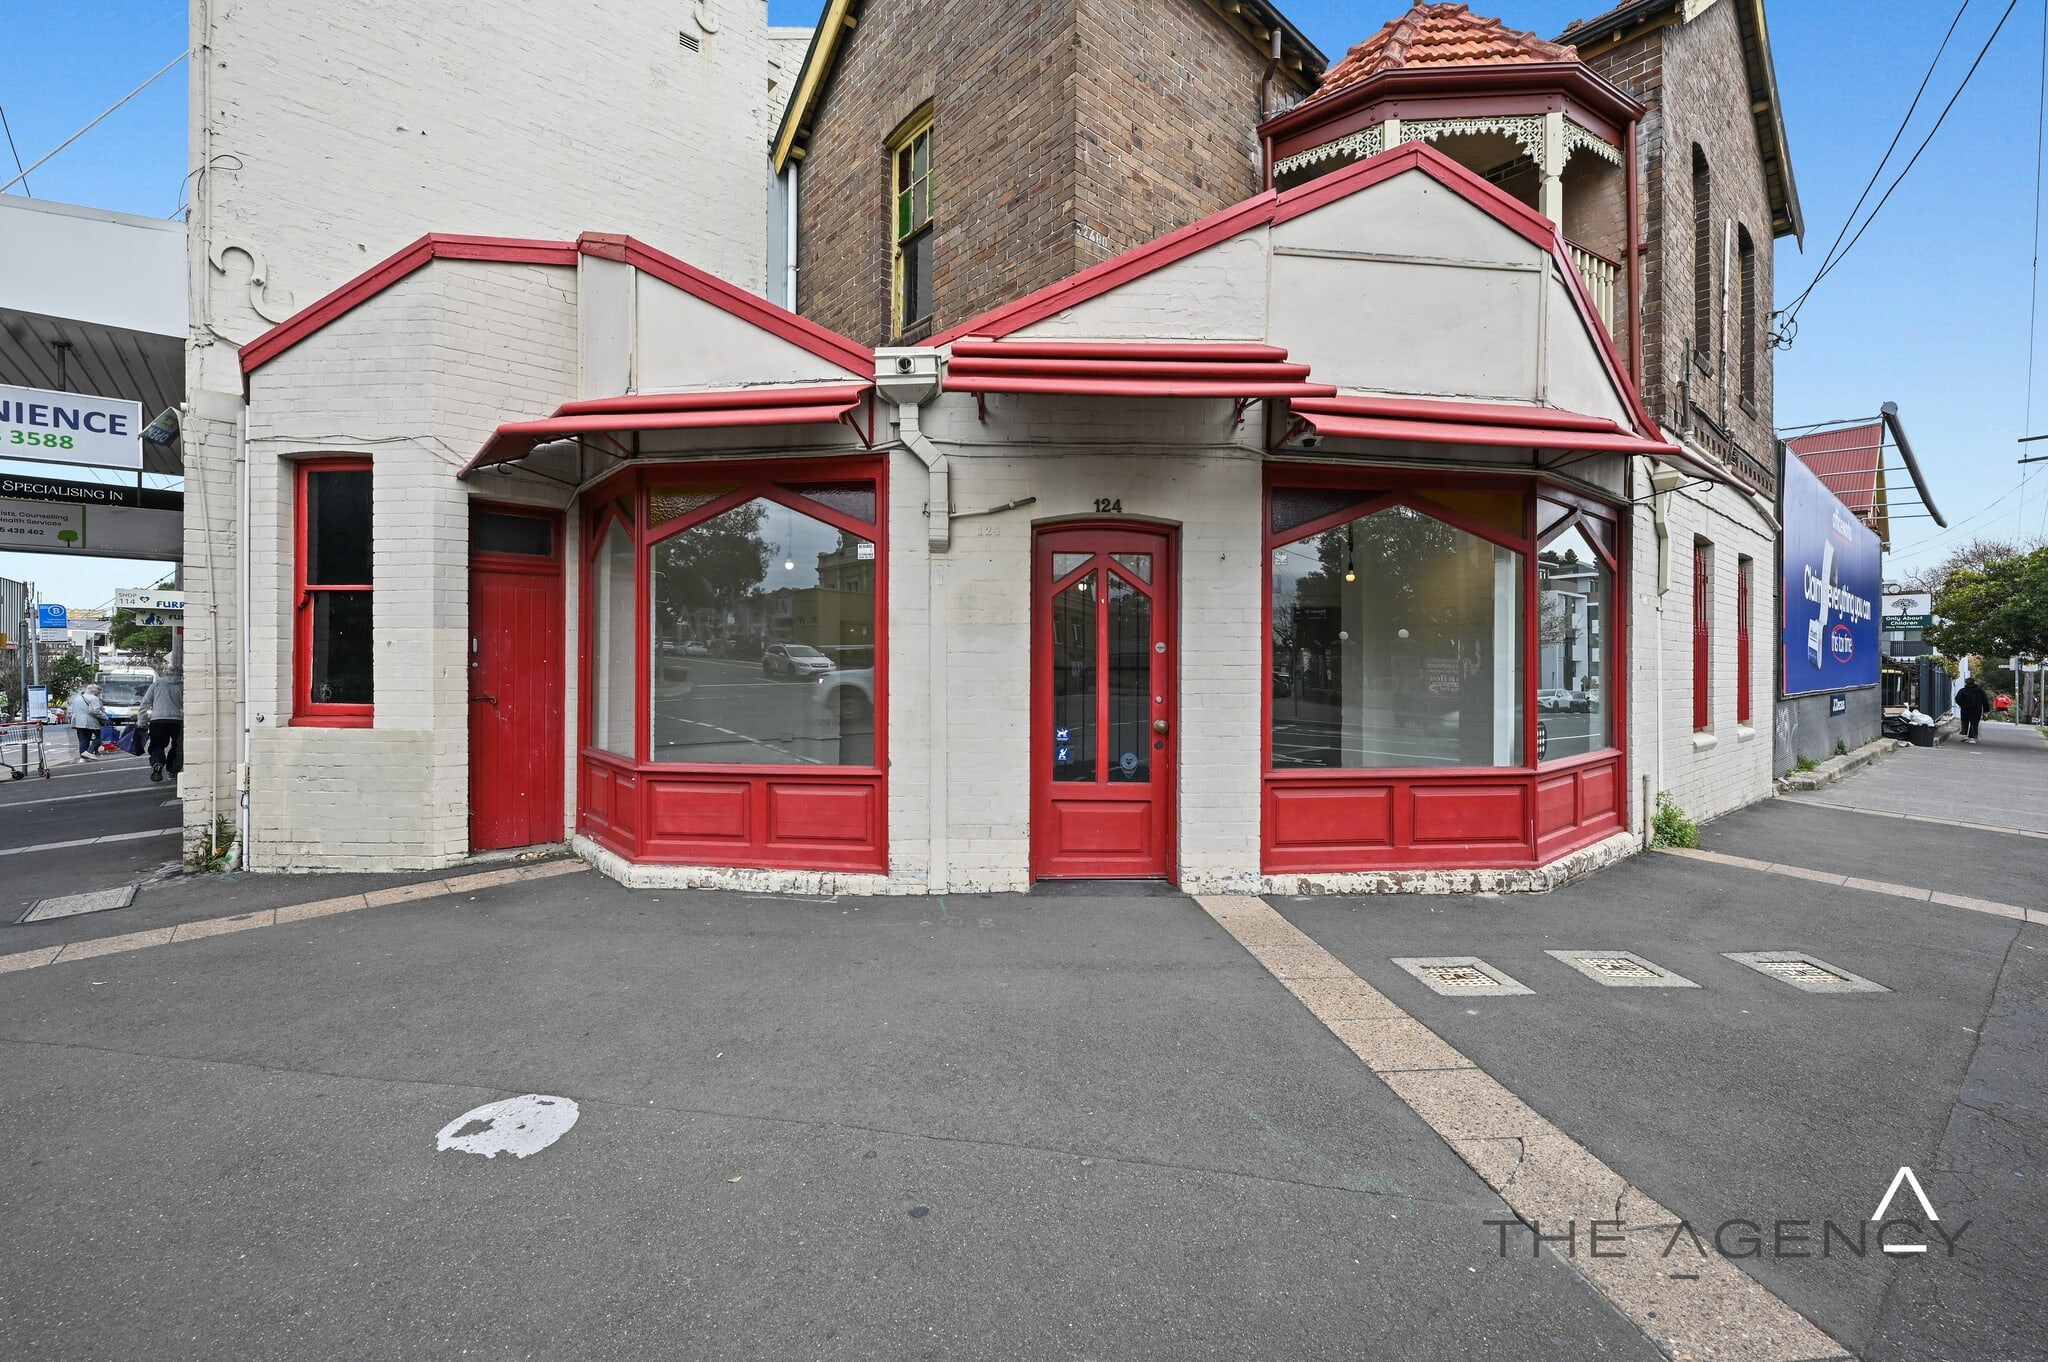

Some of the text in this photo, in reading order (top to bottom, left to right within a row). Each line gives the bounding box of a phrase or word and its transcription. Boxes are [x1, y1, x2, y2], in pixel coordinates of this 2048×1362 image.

[10, 430, 74, 449] 3588
[2, 480, 123, 501] SPECIALISING IN
[1093, 498, 1122, 513] 124
[19, 511, 69, 522] Counselling
[27, 518, 62, 527] Services
